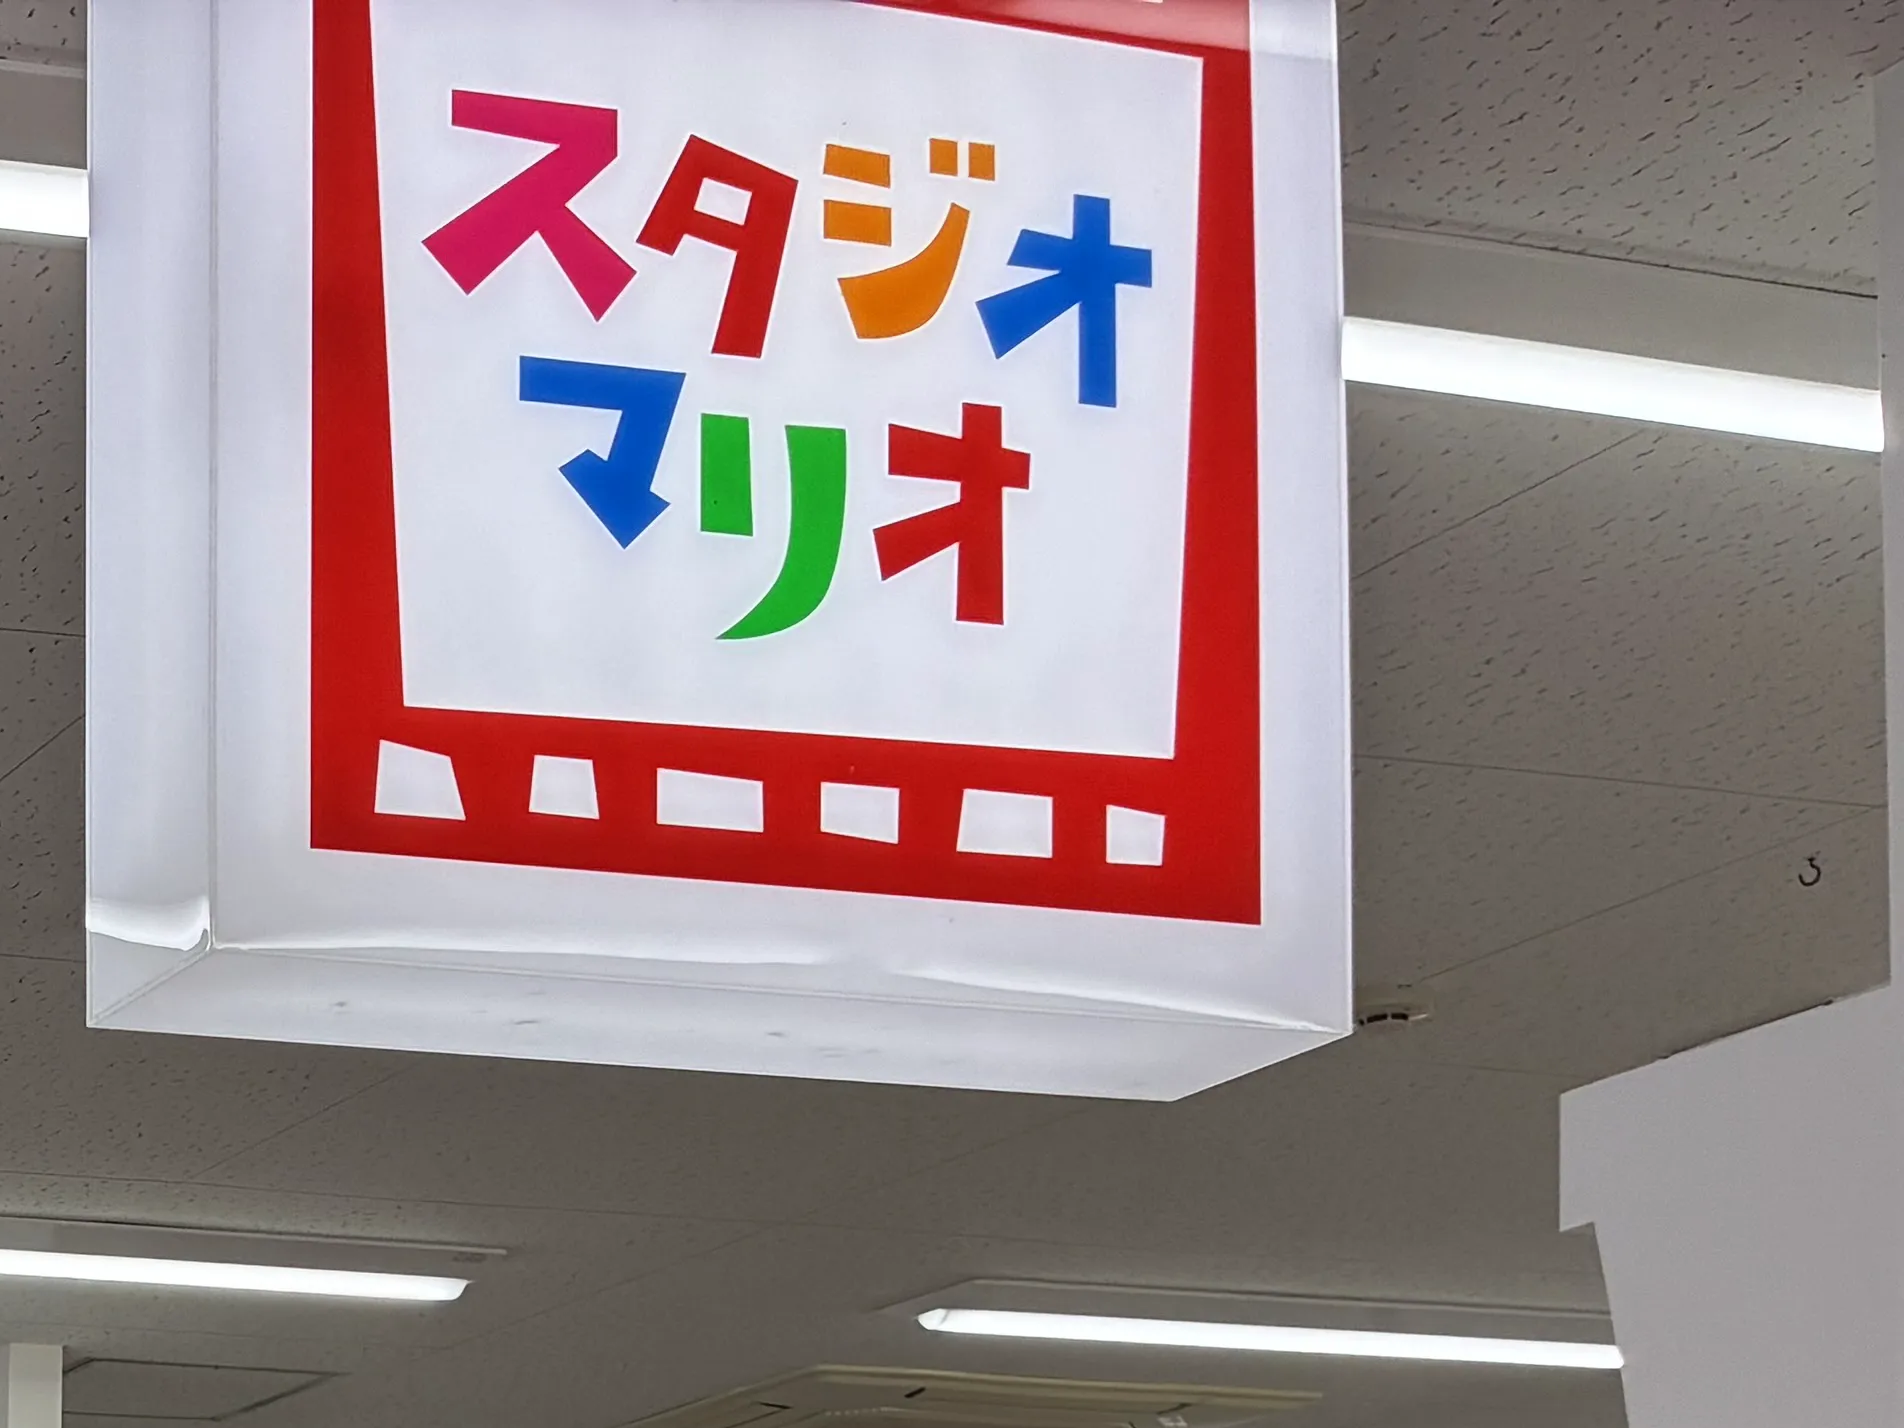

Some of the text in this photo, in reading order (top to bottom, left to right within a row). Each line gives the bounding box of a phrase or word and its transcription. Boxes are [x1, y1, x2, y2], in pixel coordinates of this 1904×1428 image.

[421, 88, 1153, 408] スタジオ
[518, 354, 1032, 641] マリオ
